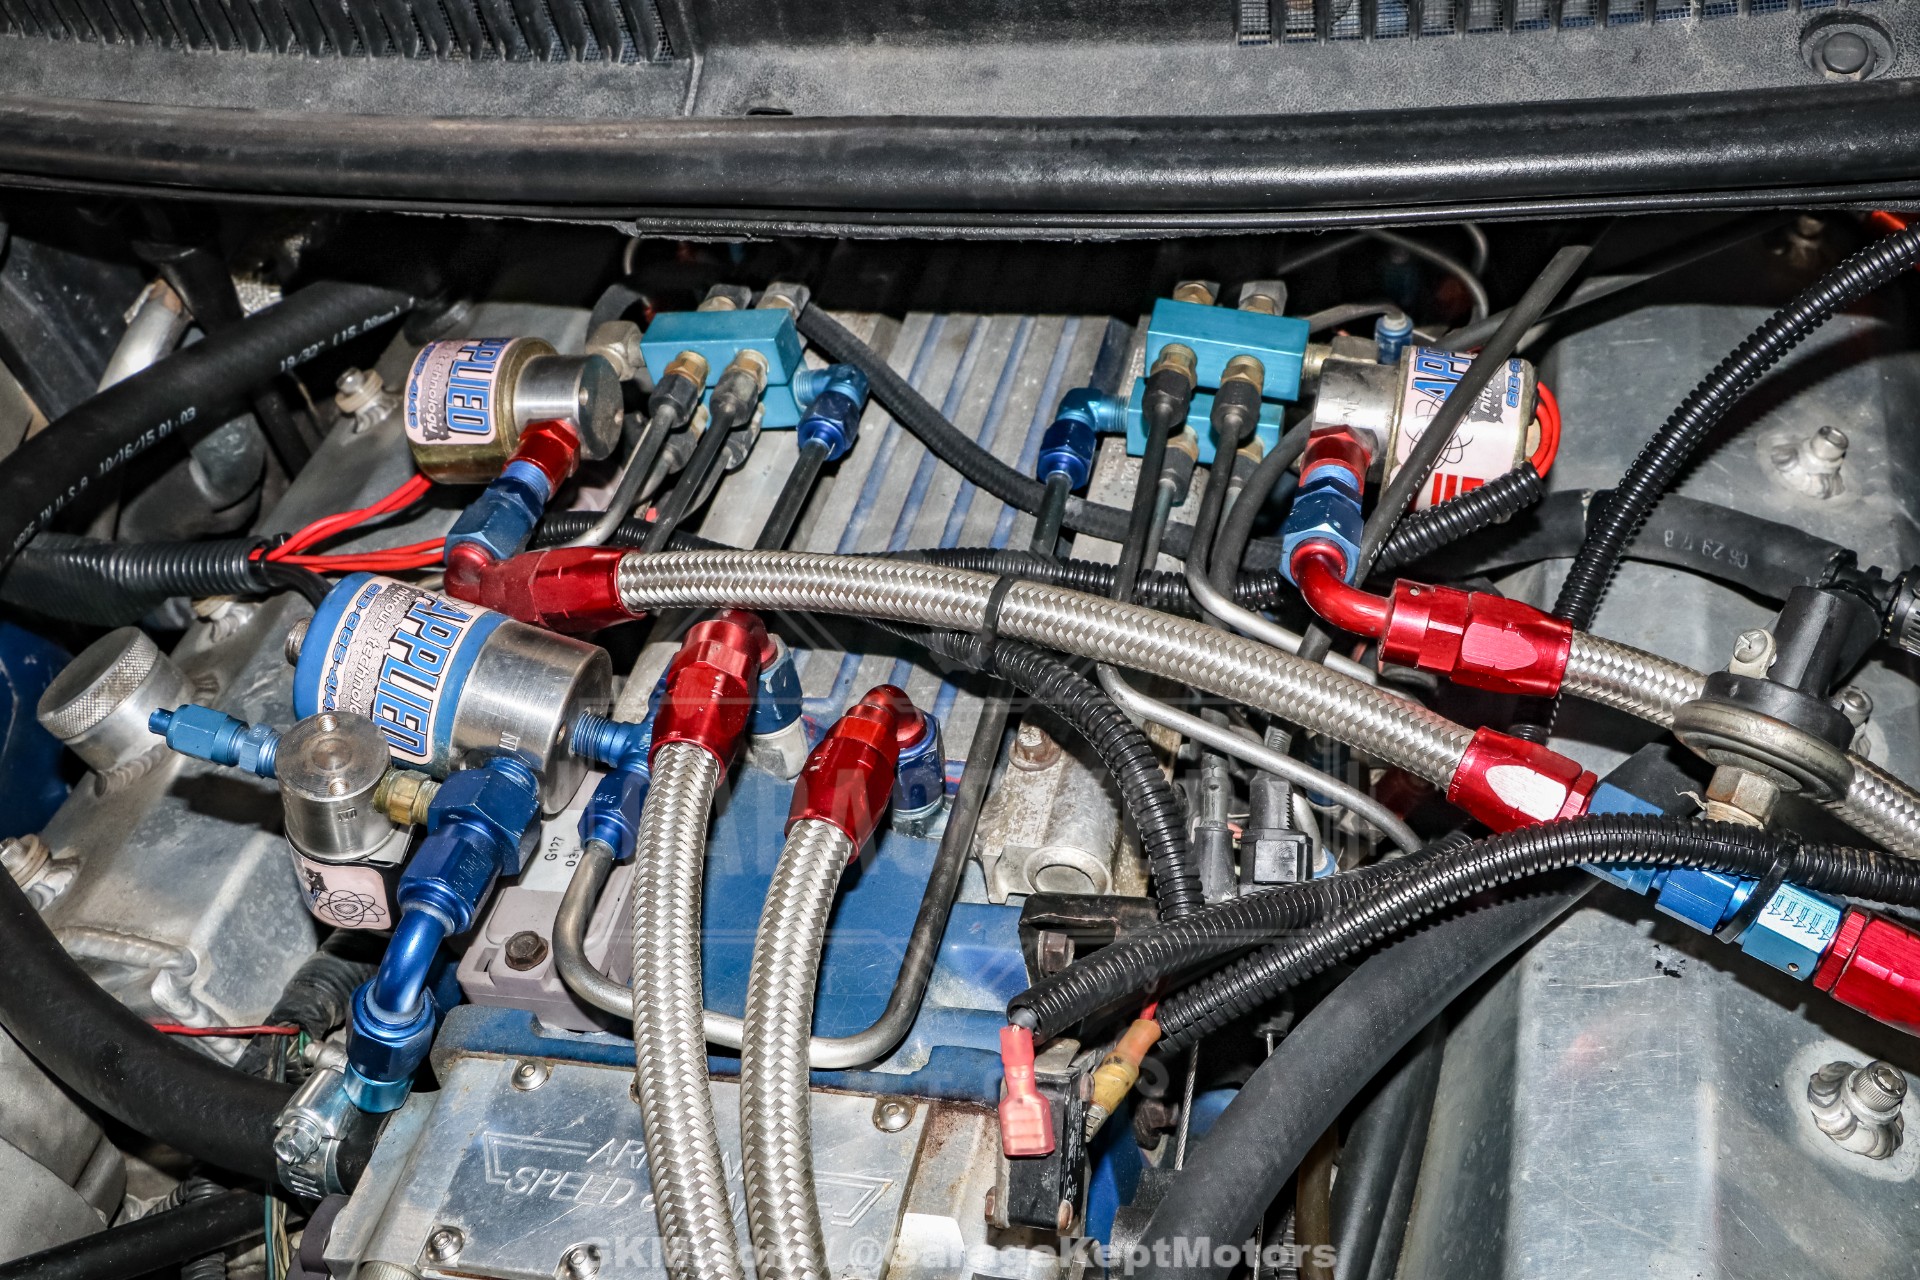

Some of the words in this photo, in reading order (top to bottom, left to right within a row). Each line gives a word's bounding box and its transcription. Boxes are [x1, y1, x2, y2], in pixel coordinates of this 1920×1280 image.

[373, 592, 473, 757] APPLIED
[544, 836, 566, 862] G127
[504, 1166, 638, 1208] SPEED
